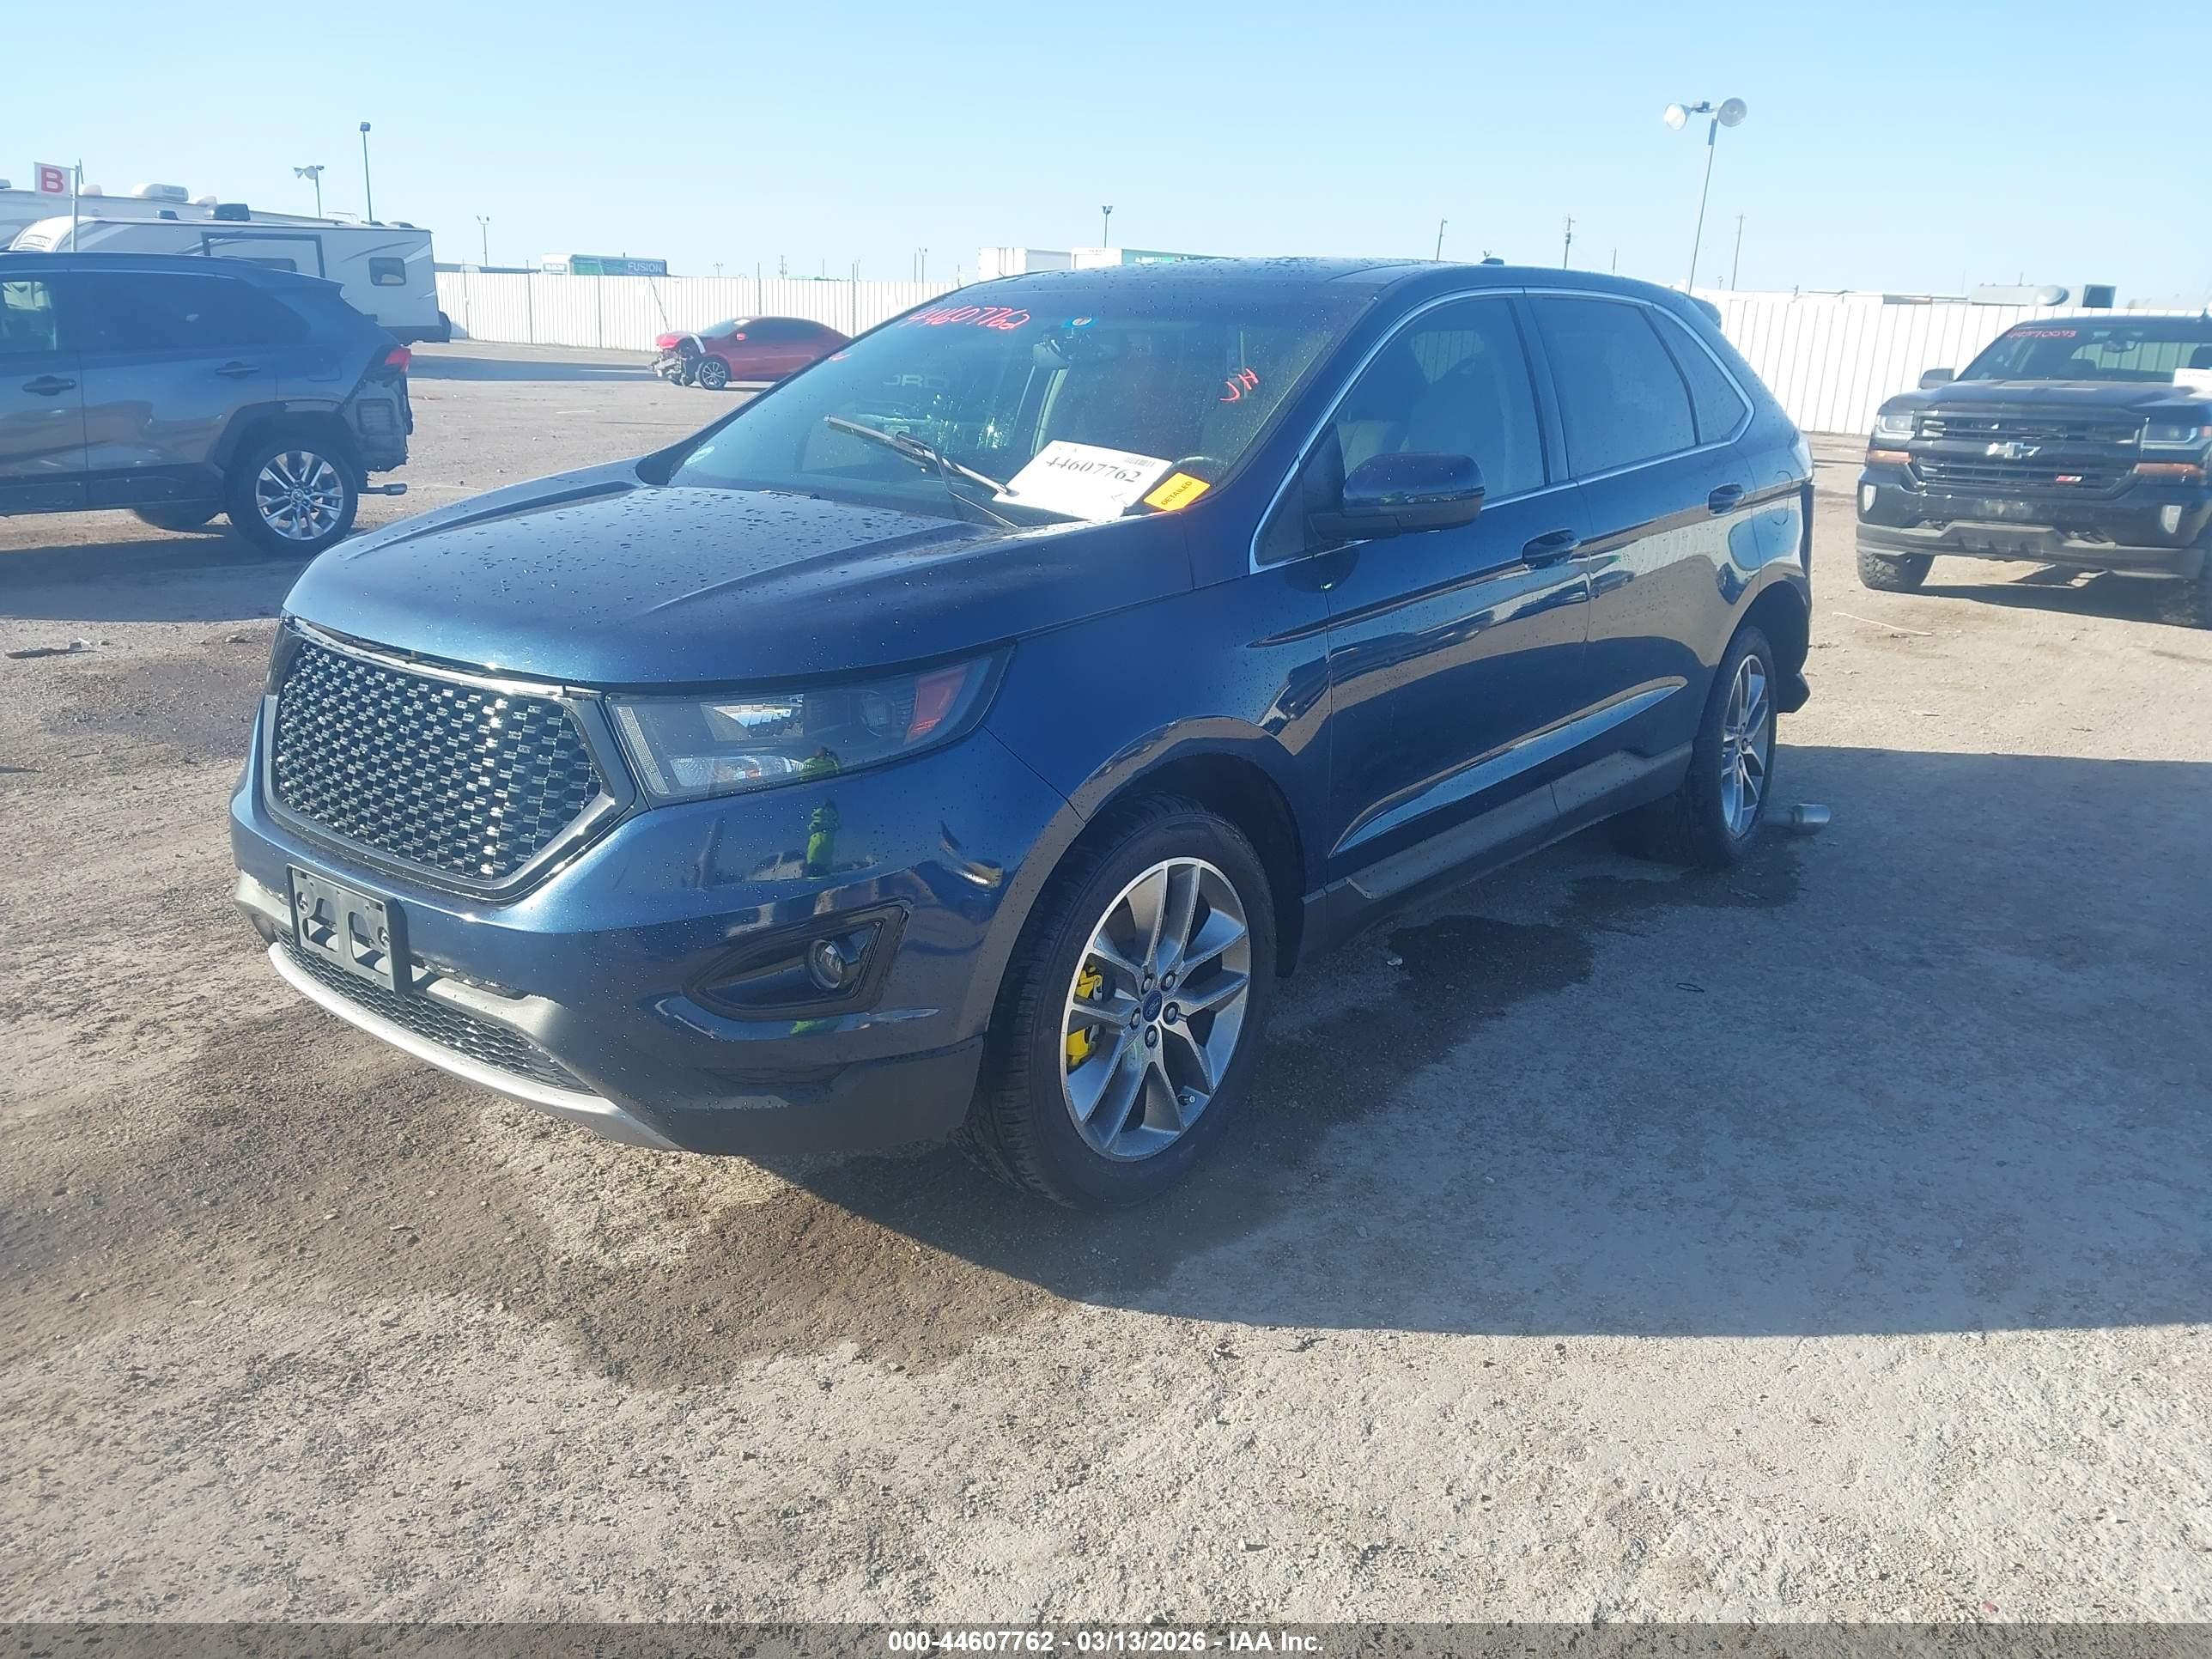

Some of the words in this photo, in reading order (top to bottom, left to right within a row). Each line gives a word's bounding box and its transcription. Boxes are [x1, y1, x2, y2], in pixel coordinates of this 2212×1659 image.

[41, 167, 64, 193] B
[627, 260, 663, 273] FUSION
[898, 305, 1030, 331] 44607762
[1046, 456, 1142, 483] 44607762
[1159, 480, 1194, 507] DETAILED
